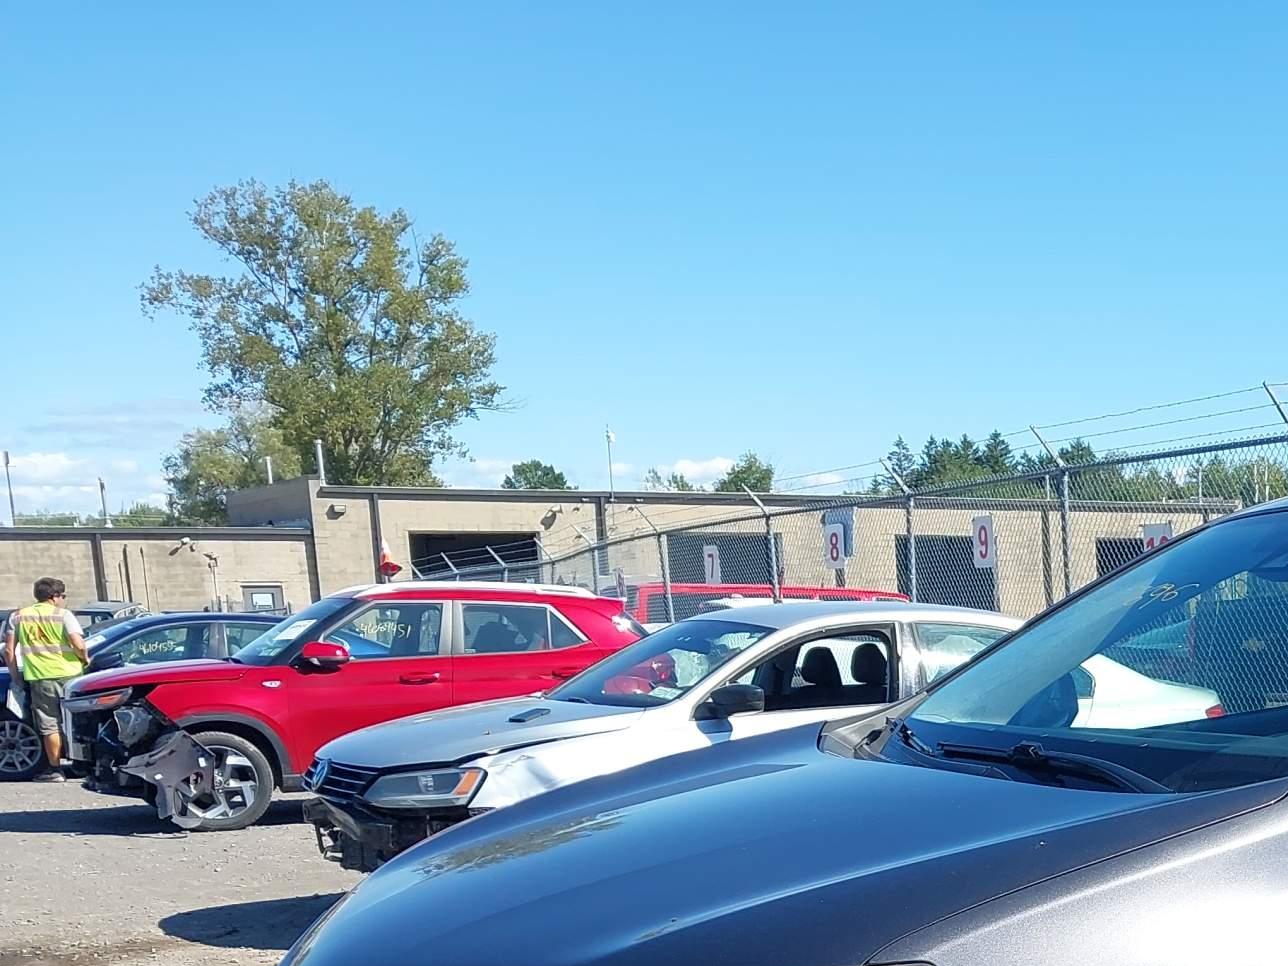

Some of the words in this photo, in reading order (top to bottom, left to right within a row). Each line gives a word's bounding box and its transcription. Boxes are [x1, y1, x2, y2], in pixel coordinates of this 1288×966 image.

[829, 532, 841, 562] 8
[976, 524, 990, 560] 9
[706, 553, 716, 579] 7
